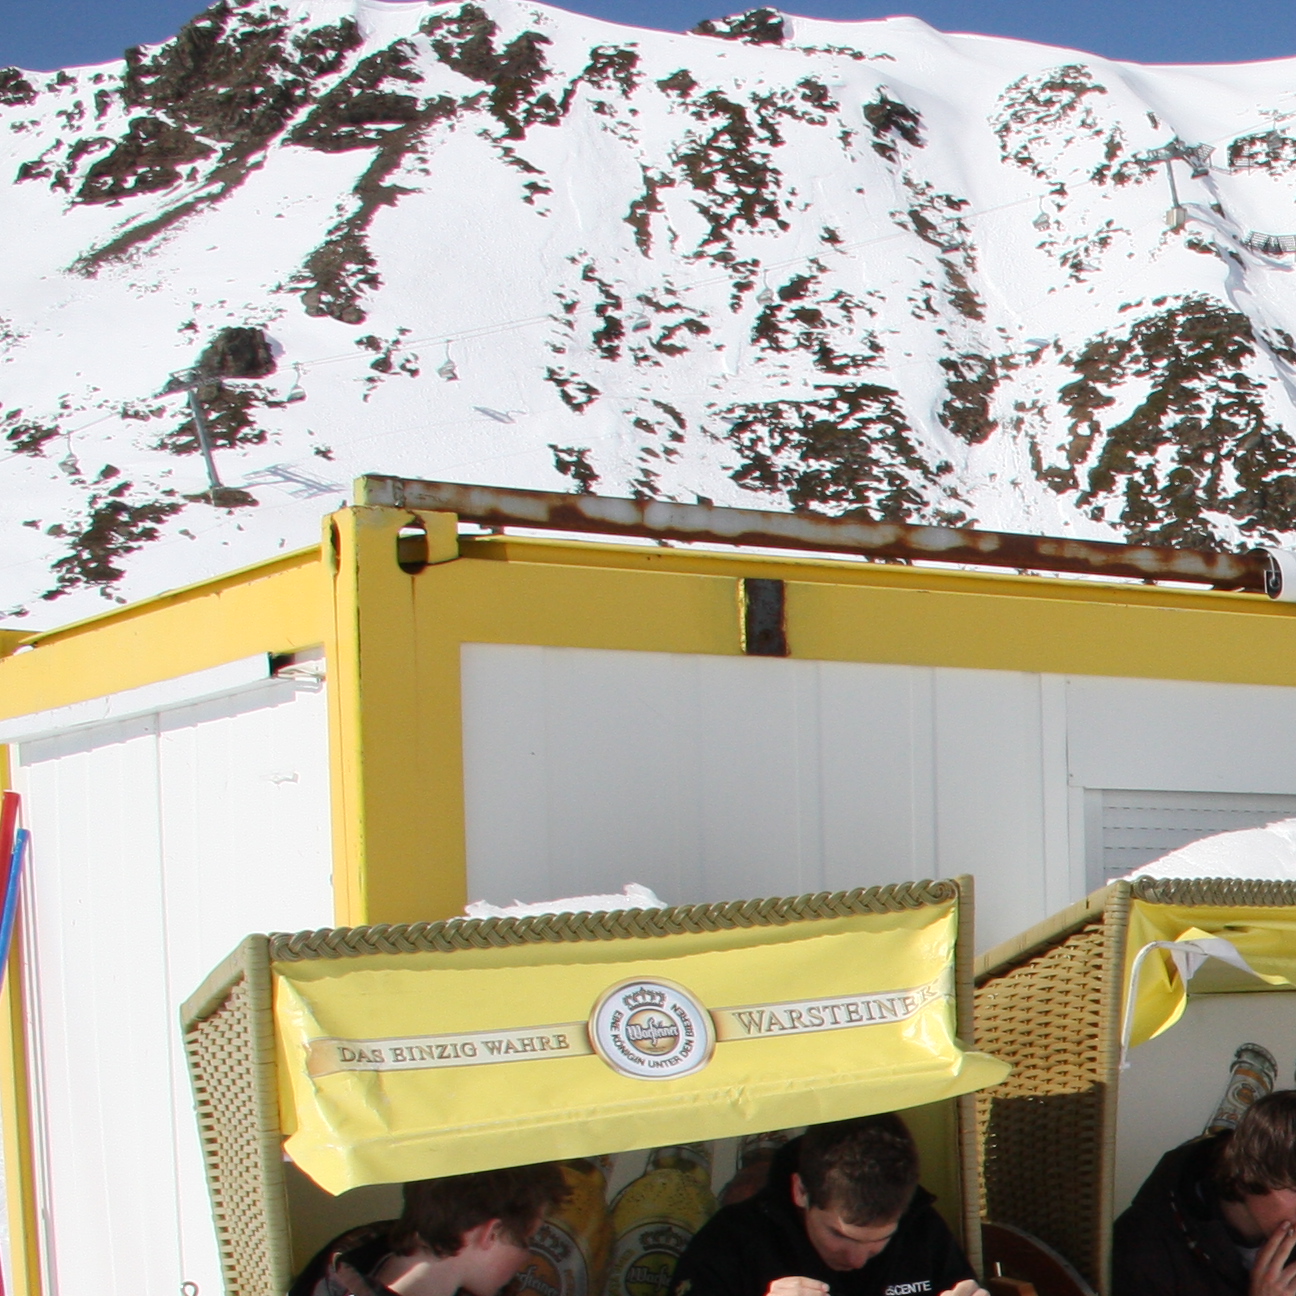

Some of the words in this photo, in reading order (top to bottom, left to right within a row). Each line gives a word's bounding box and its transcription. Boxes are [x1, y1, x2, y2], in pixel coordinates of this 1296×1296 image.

[338, 1045, 384, 1065] DAS
[392, 1037, 478, 1063] EINZIG
[484, 1033, 570, 1057] WAHRE
[647, 1055, 684, 1069] UNTER
[681, 1039, 695, 1059] DEN
